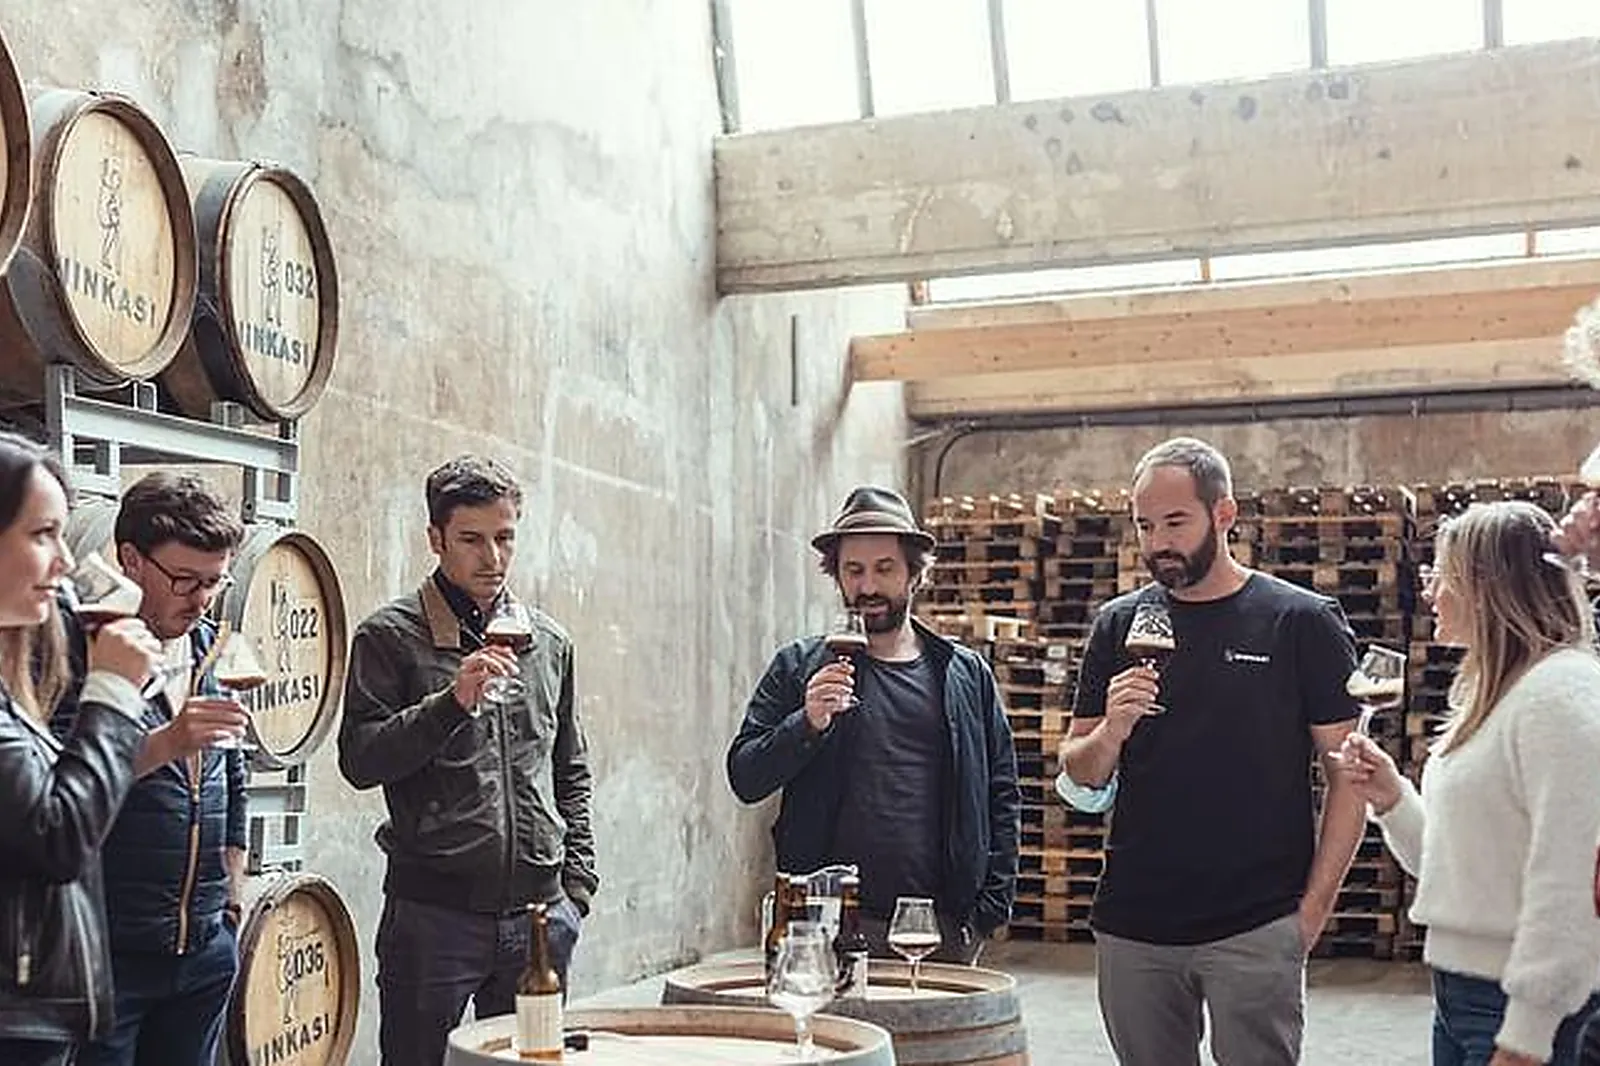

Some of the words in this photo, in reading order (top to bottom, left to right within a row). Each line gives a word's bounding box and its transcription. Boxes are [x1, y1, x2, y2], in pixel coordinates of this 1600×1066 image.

[285, 261, 315, 299] 032
[290, 607, 318, 639] 022
[294, 942, 324, 978] 036
